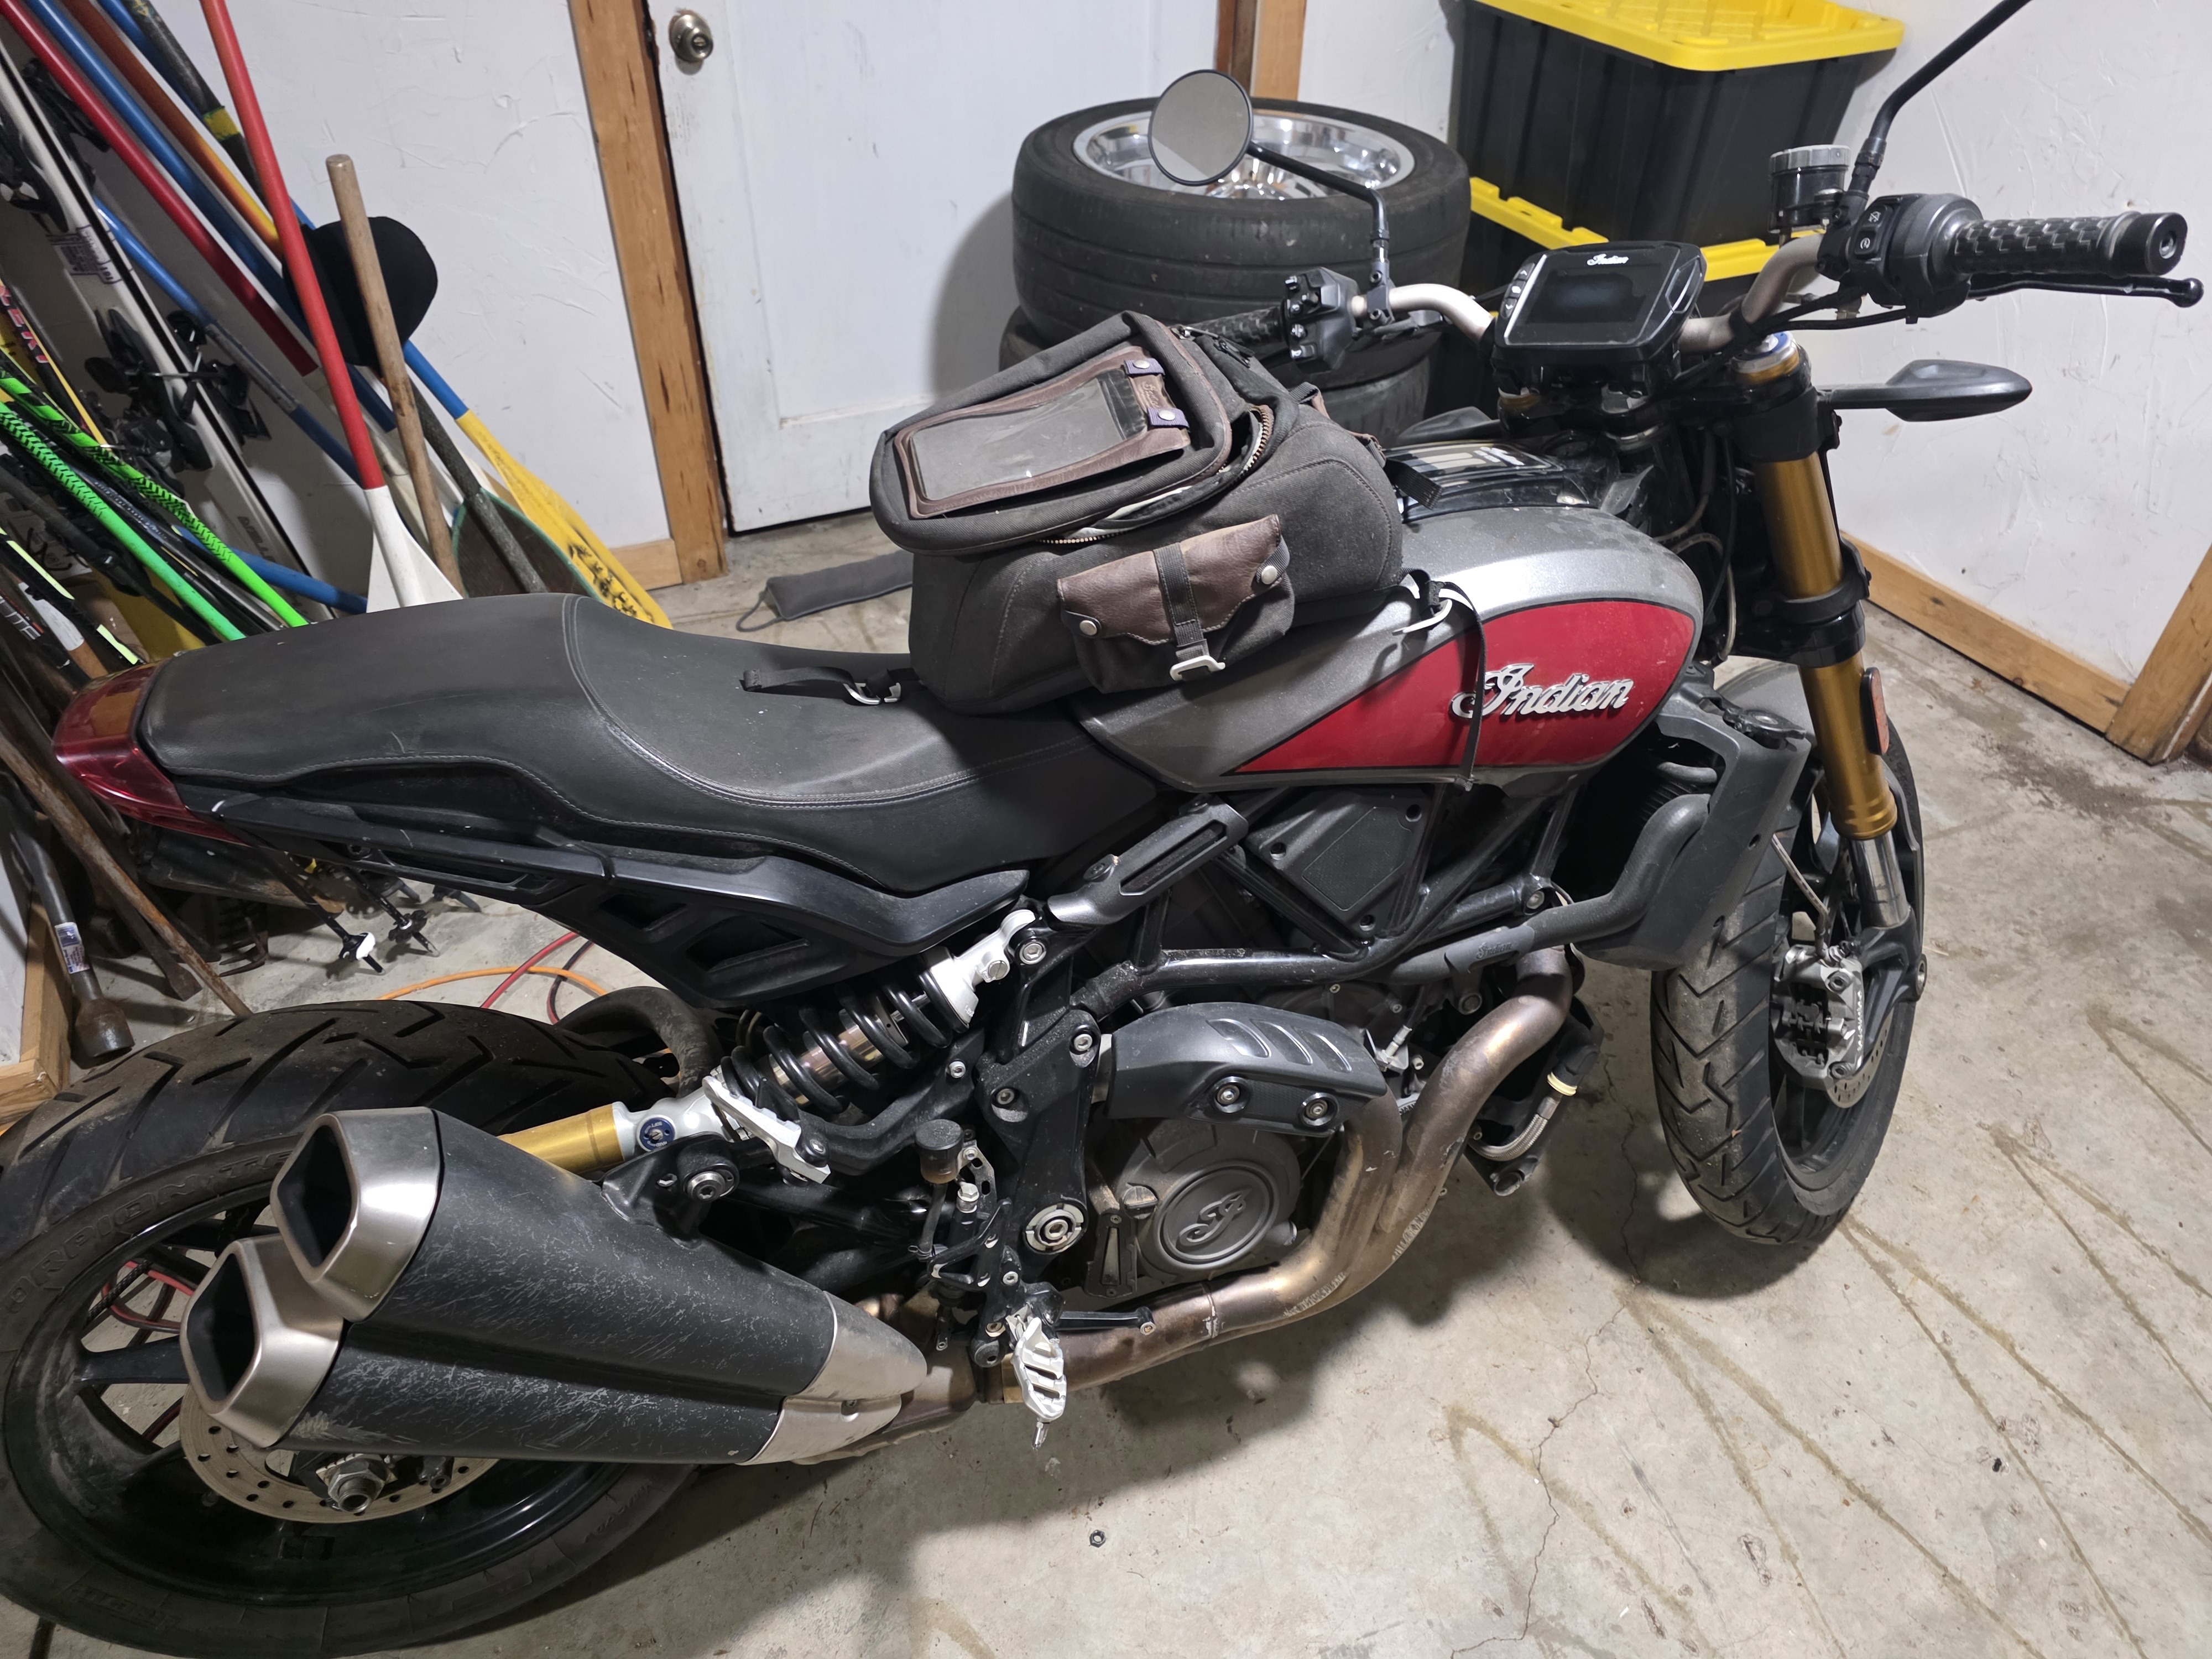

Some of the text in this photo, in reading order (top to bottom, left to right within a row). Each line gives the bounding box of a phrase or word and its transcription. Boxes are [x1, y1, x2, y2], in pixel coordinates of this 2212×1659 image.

[1587, 253, 1629, 266] Indian
[1449, 663, 1634, 719] Indian
[1476, 942, 1512, 959] Indian
